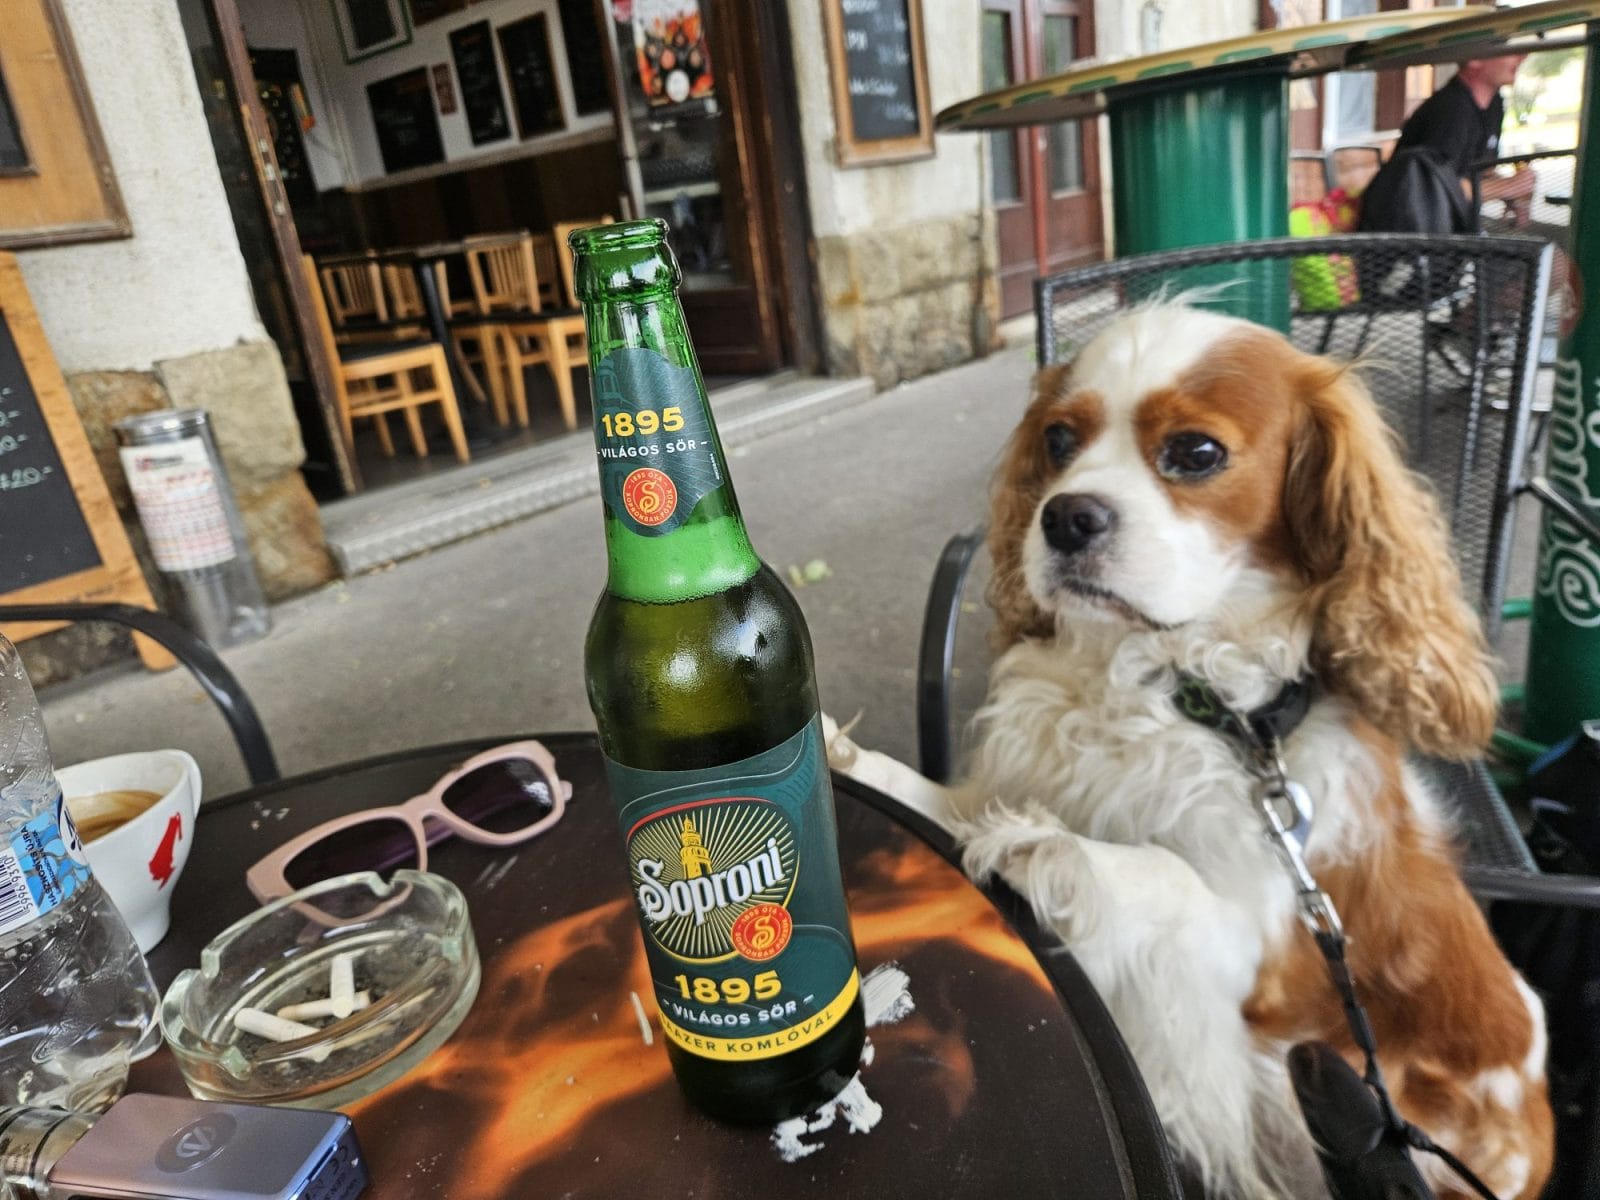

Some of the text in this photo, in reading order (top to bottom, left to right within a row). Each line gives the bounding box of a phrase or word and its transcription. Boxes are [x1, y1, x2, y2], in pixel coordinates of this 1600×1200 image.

[602, 407, 685, 438] 1895
[601, 439, 697, 459] VILÁGOS SÖR
[21, 826, 35, 853] ÚJRA
[3, 857, 33, 912] 5996 9310
[638, 837, 786, 926] Soproni
[675, 970, 782, 1004] 1895
[672, 999, 799, 1026] VILÁGOS SÖR
[727, 1010, 834, 1053] KOMLÓVAL
